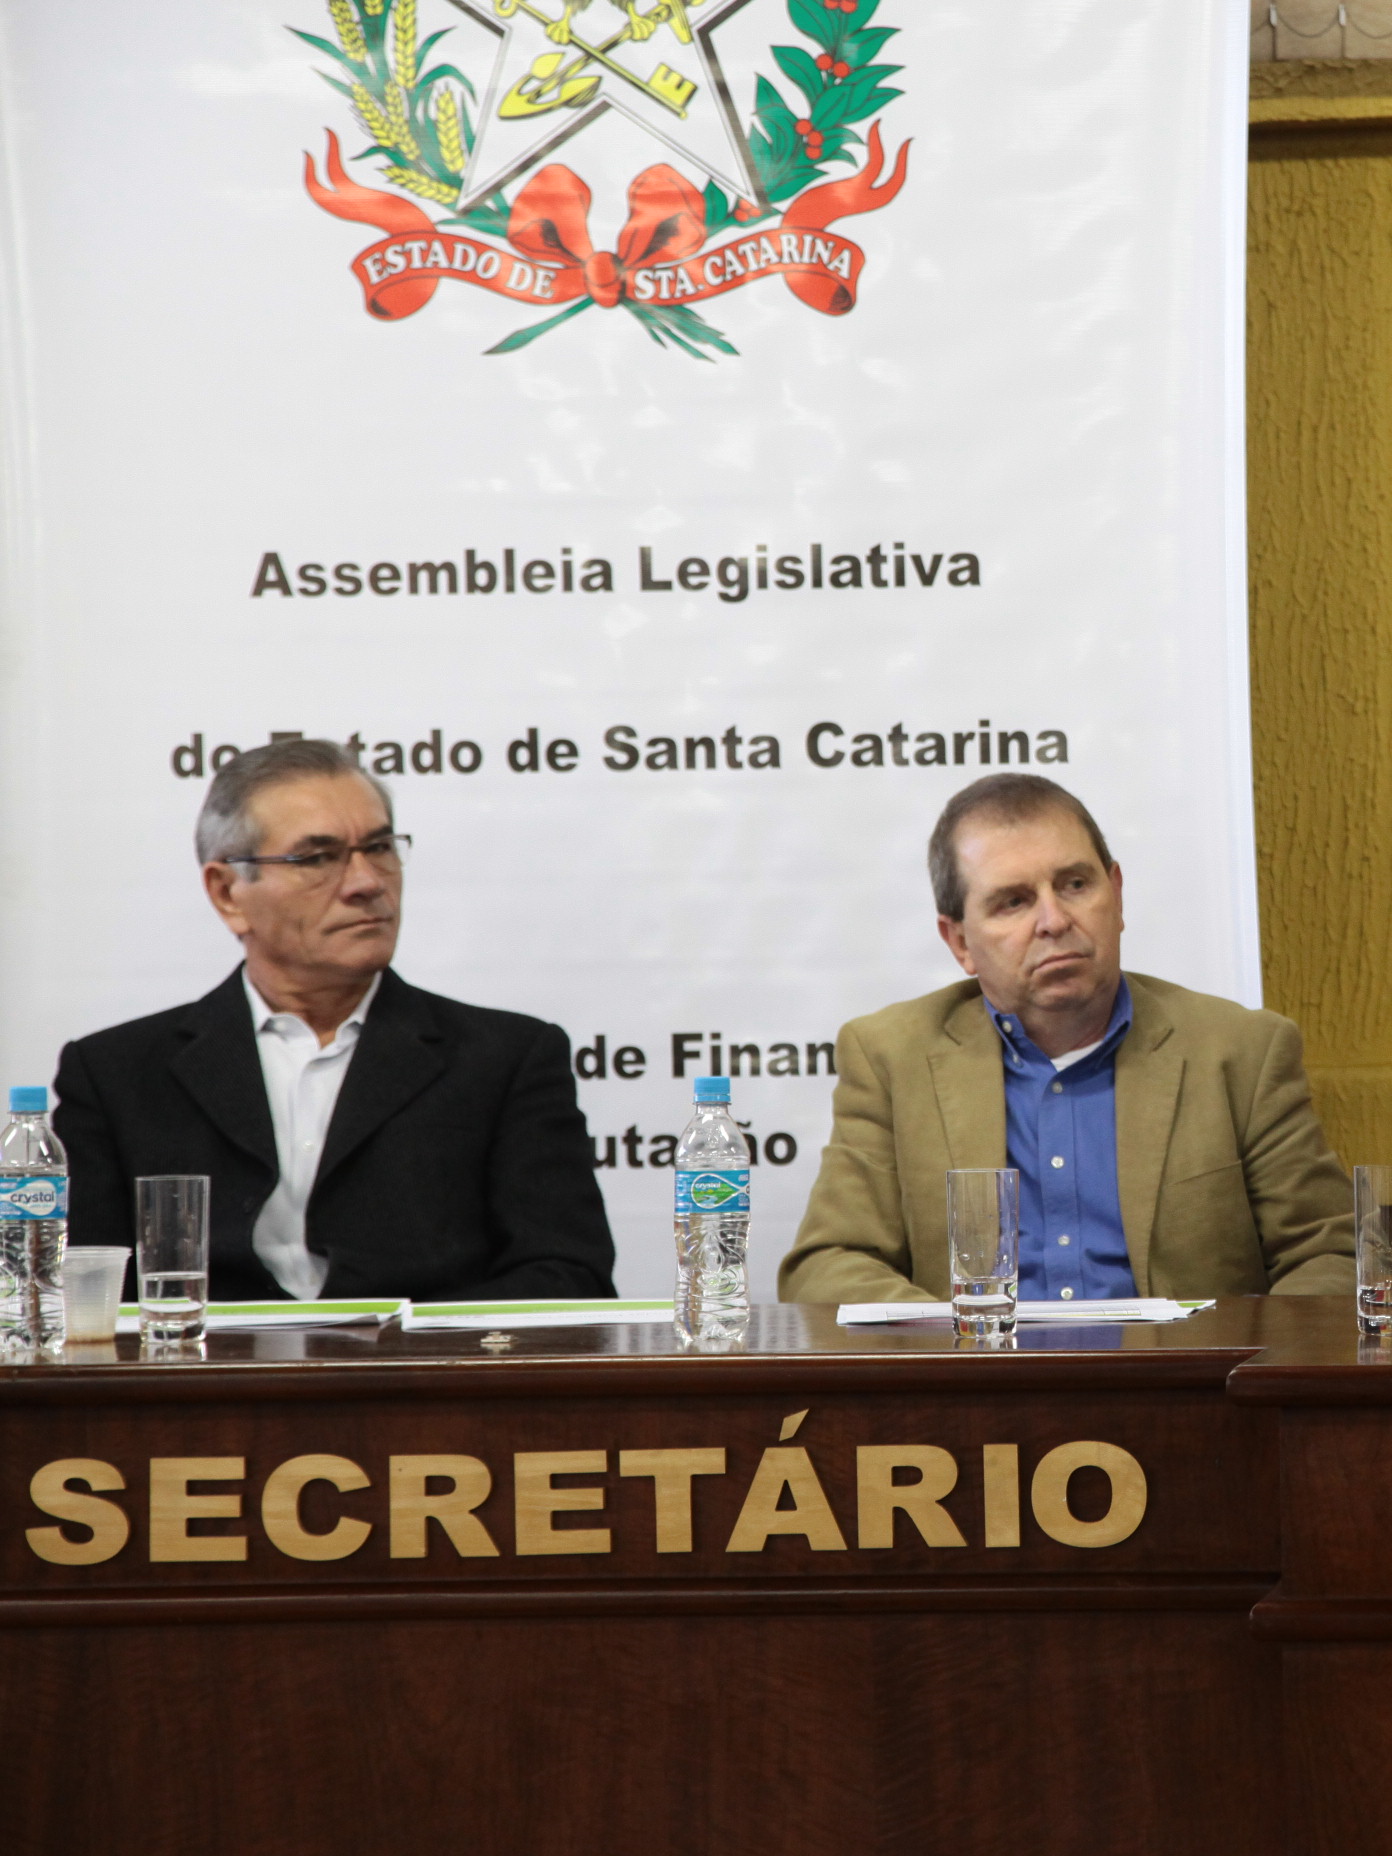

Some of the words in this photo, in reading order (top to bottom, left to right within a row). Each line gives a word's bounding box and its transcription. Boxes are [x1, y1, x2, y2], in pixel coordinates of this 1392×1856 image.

[363, 238, 500, 285] ESTADO
[506, 258, 556, 299] DE
[703, 233, 854, 282] CATARINA
[251, 546, 615, 597] Assembleia
[639, 542, 982, 604] Legislativa
[270, 729, 482, 776] tado
[506, 728, 580, 773] de
[603, 724, 782, 772] Santa
[806, 718, 1070, 768] Catarina
[575, 1035, 647, 1079] de
[10, 1191, 54, 1204] crystal
[25, 1408, 1148, 1566] SECRETÁRIO
